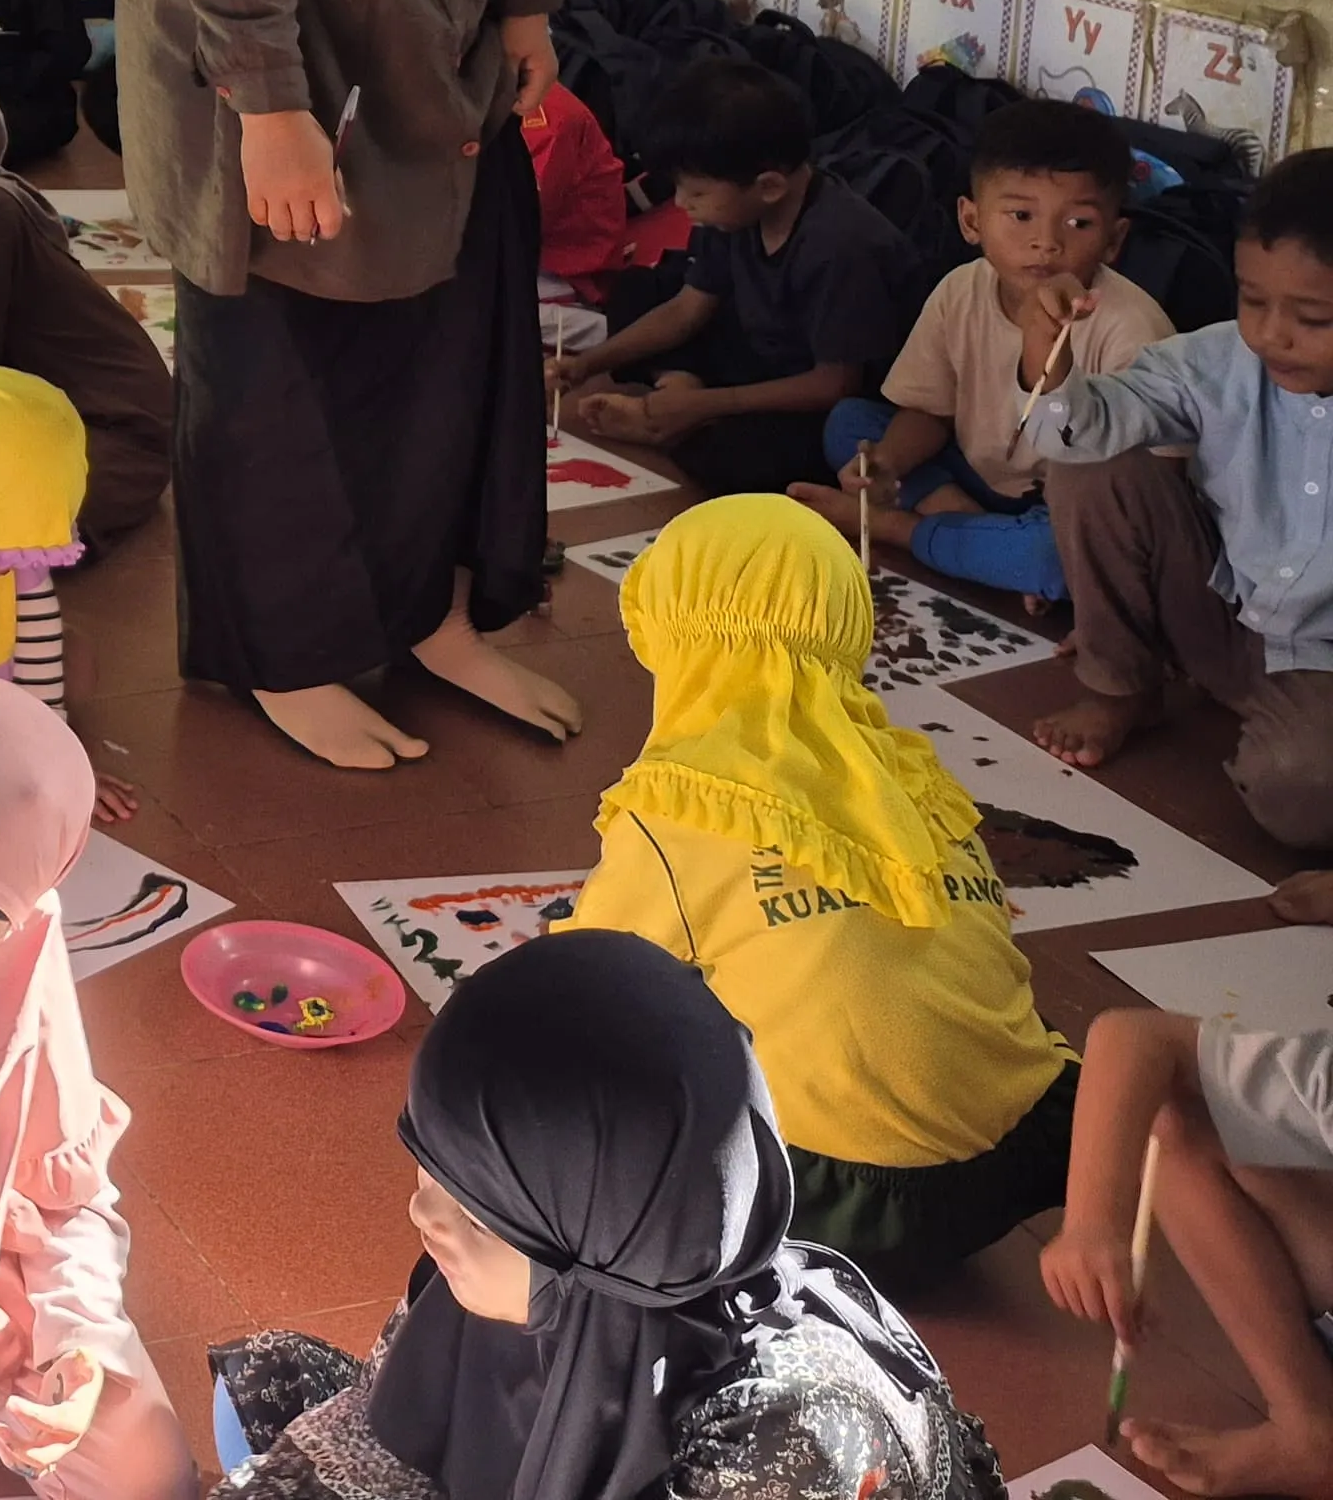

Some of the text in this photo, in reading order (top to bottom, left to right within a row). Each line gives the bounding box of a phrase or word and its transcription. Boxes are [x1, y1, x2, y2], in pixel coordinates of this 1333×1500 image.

[1064, 6, 1102, 56] Yy
[1203, 42, 1242, 86] Zz
[750, 864, 783, 892] TK
[758, 885, 870, 927] KUAL
